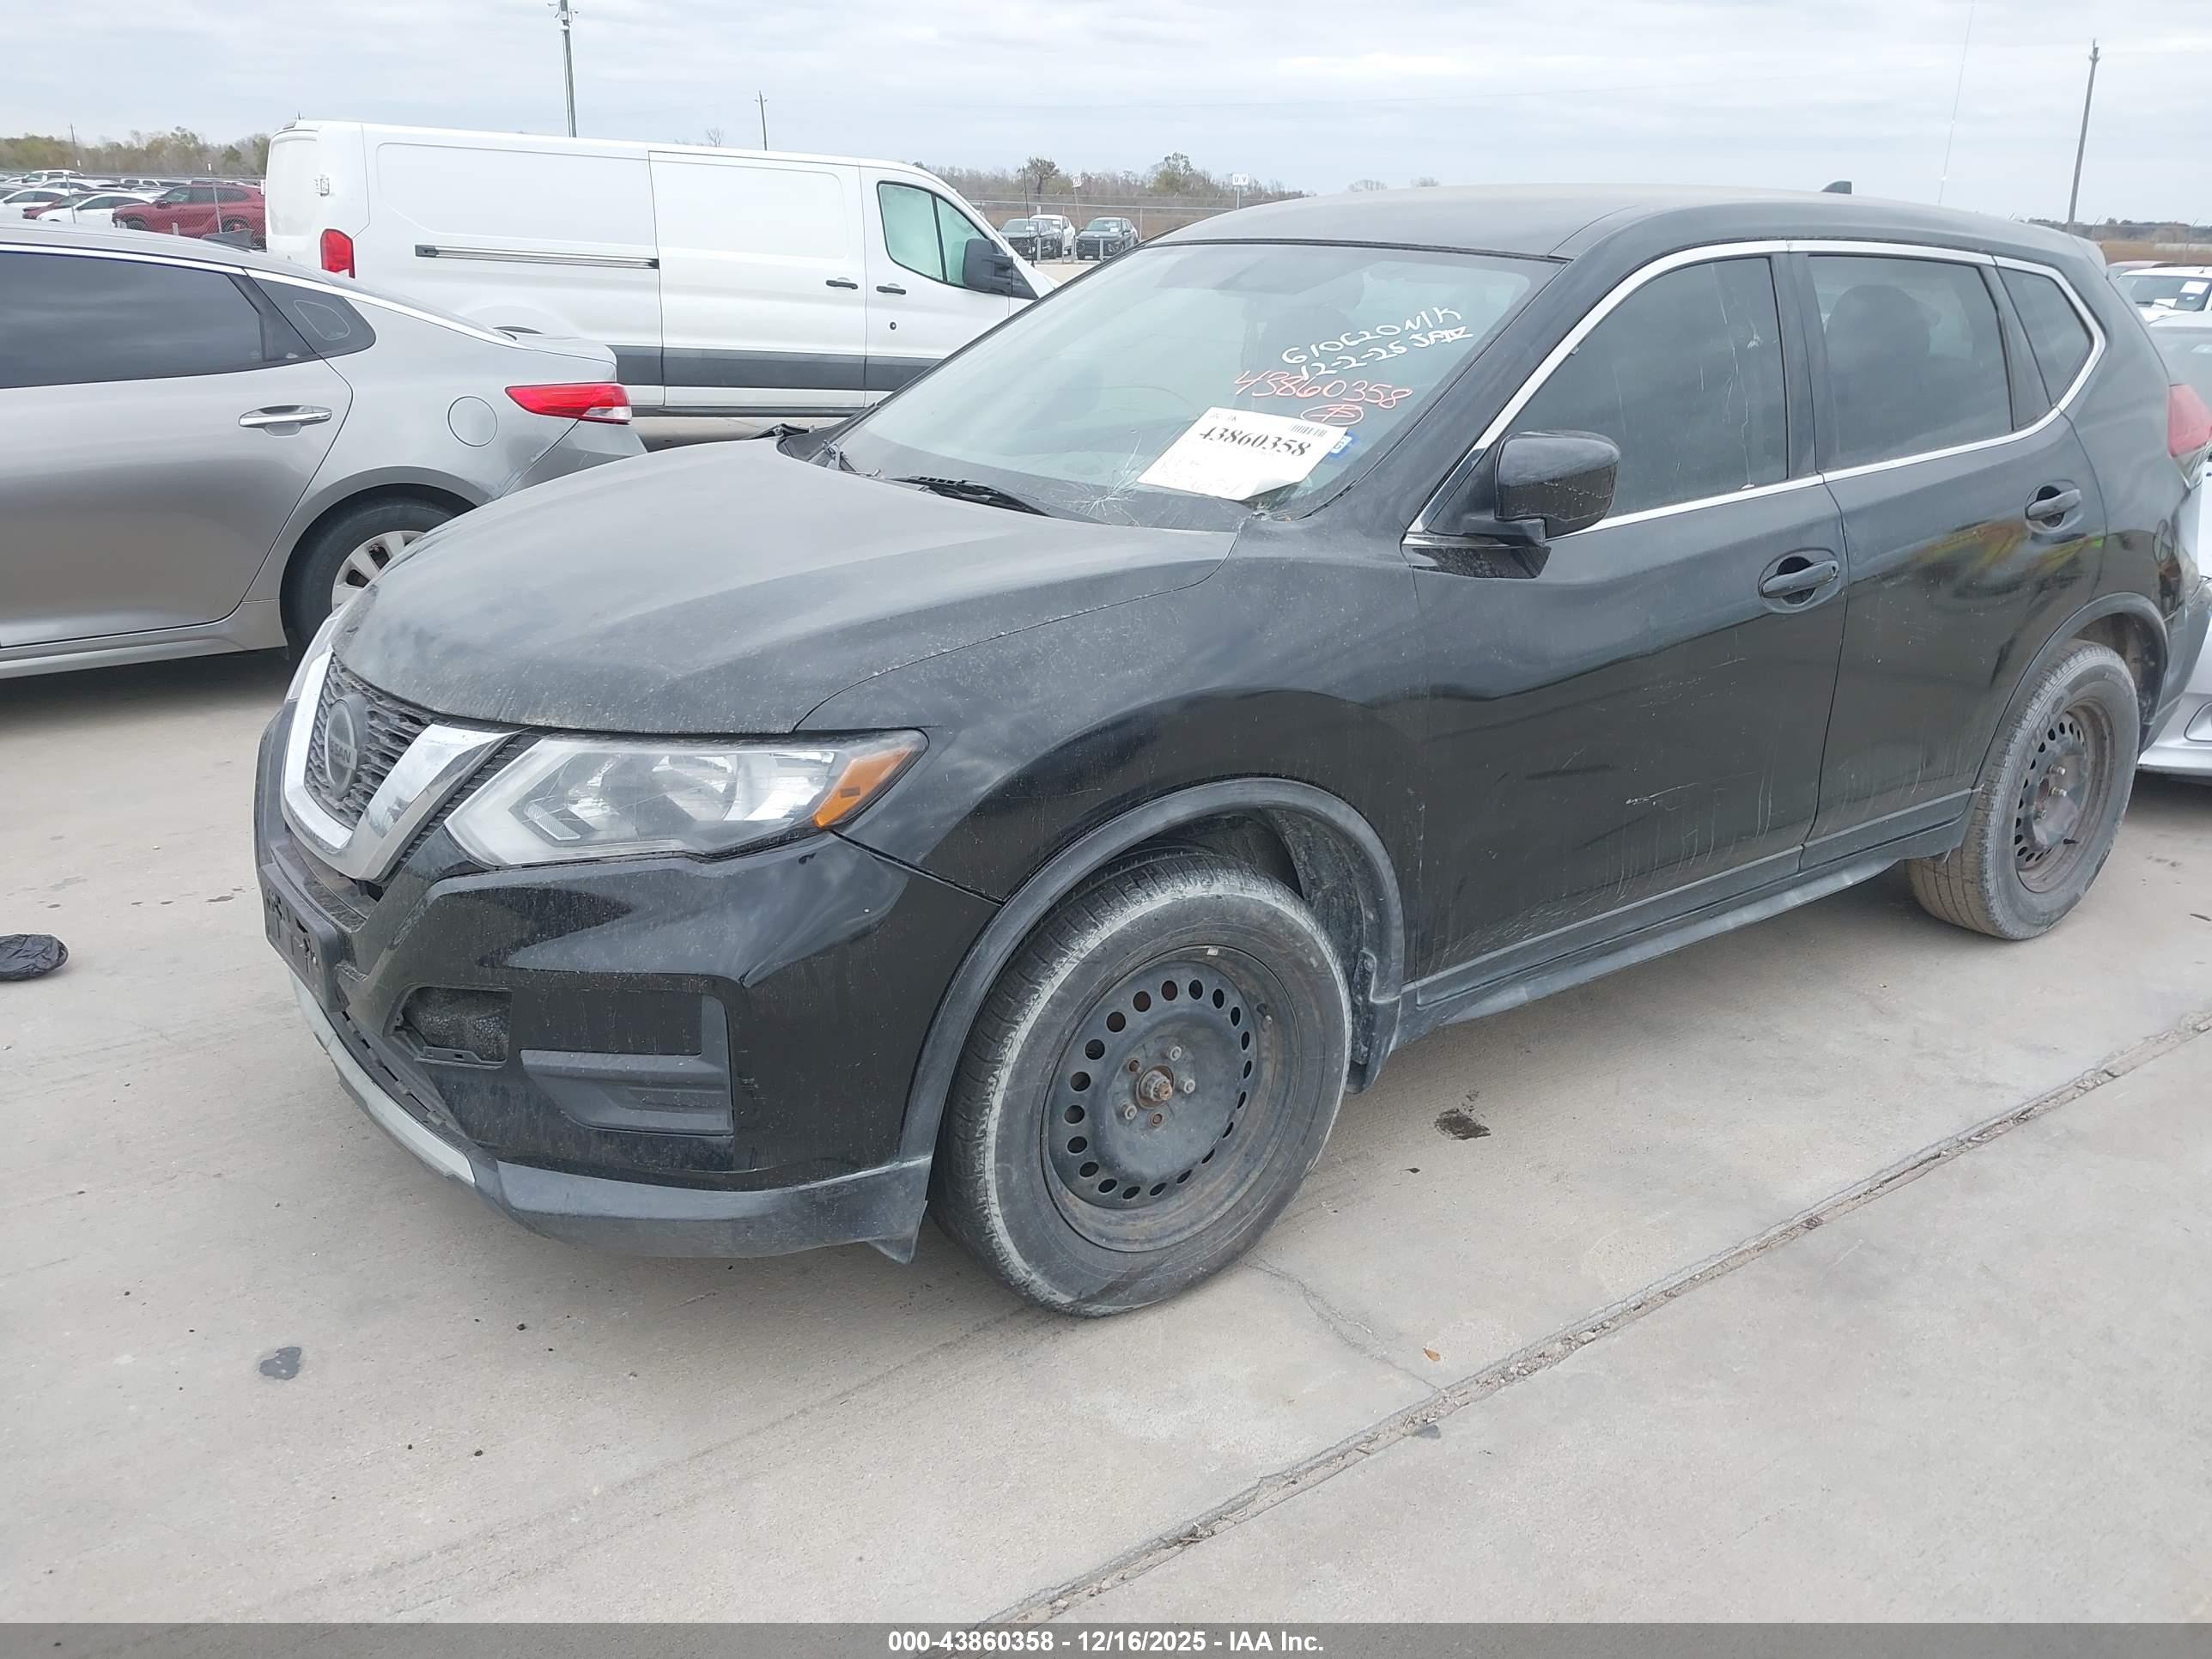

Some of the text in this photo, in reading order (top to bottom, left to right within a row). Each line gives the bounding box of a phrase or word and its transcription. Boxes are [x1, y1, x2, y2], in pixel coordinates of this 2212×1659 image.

[1301, 340, 1407, 380] 12-2-25
[1234, 370, 1413, 409] 43860358
[1200, 426, 1311, 457] 43860358
